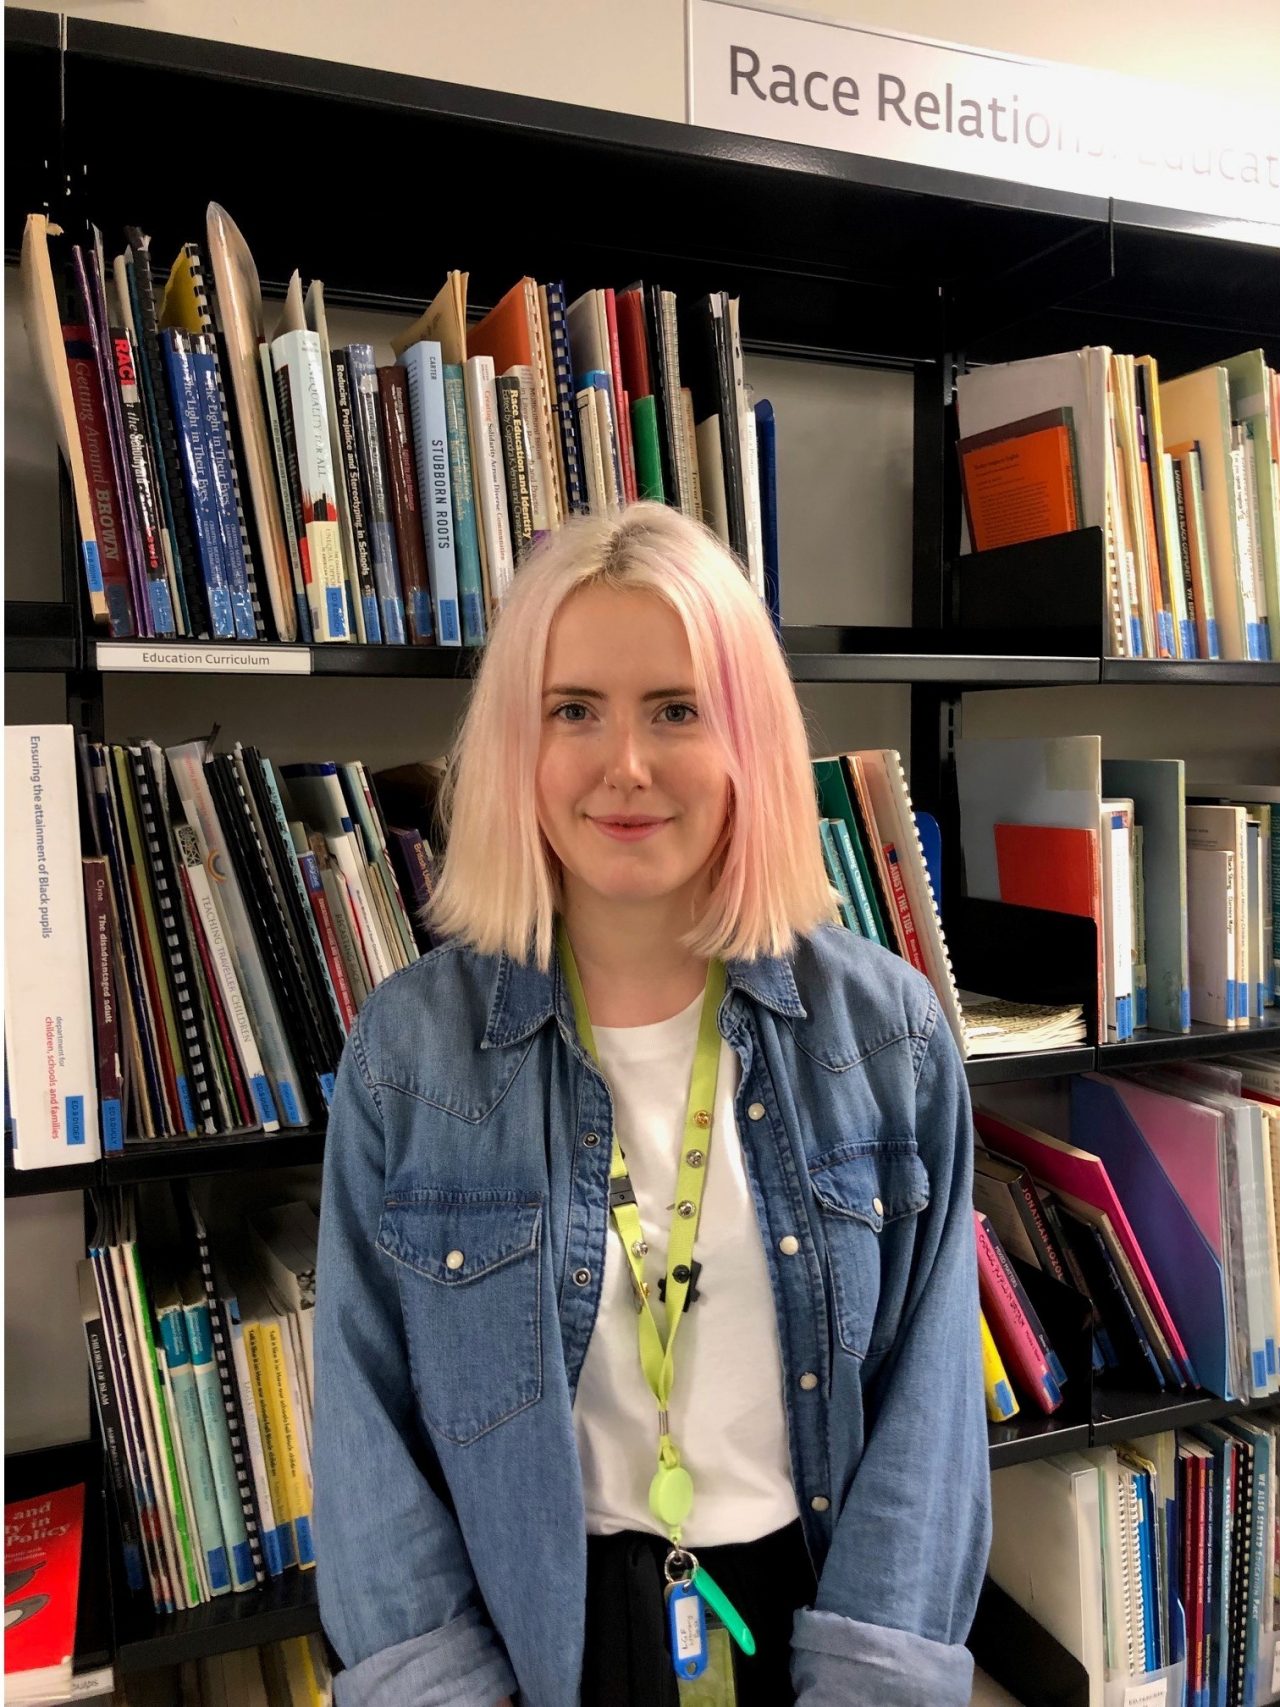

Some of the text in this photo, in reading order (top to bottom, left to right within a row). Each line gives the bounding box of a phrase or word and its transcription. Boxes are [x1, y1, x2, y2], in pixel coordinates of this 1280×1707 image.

[729, 45, 861, 116] Race
[429, 356, 437, 379] CARTER
[72, 361, 97, 421] Getting
[502, 389, 512, 412] Edited
[184, 398, 199, 427] Light
[205, 404, 221, 433] Light
[304, 362, 322, 429] EQUALITY
[315, 457, 326, 477] ALL
[503, 414, 512, 423] by
[83, 423, 107, 483] Around
[191, 430, 201, 442] in
[212, 435, 223, 447] in
[513, 418, 525, 472] Education
[193, 445, 206, 474] Their
[214, 450, 228, 479] Their
[335, 364, 370, 574] Reducing Prejudice and Stereotyping in Schools
[486, 423, 497, 458] Solidarity
[493, 484, 501, 510] Diverse
[431, 439, 450, 549] STUBBORN ROOTS
[512, 489, 520, 504] and
[518, 474, 527, 493] and
[94, 487, 120, 561] BROWN
[519, 495, 532, 538] Identity
[142, 651, 270, 667] Education Curriculum
[26, 736, 52, 938] Ensuring the attainment of Black pupils
[95, 879, 105, 901] Clyne
[841, 833, 877, 937] Teaching Chinese Children
[896, 894, 914, 934] THE TIDE
[96, 914, 113, 1023] The disadvantaged adult
[200, 896, 252, 1042] TEACHING TRAVELLER CHILDREN
[55, 1016, 64, 1056] department
[44, 1017, 60, 1138] children, schools and families
[1021, 1186, 1065, 1280] JONATHAN KOZOL
[994, 1245, 1018, 1288] MIXED MATTERS
[90, 1333, 109, 1405] CHILDREN OF ISLAM
[1258, 1473, 1265, 1486] WE
[13, 1501, 51, 1520] and
[31, 1517, 51, 1530] in
[1255, 1515, 1263, 1546] SERVED
[6, 1523, 71, 1547] Policy
